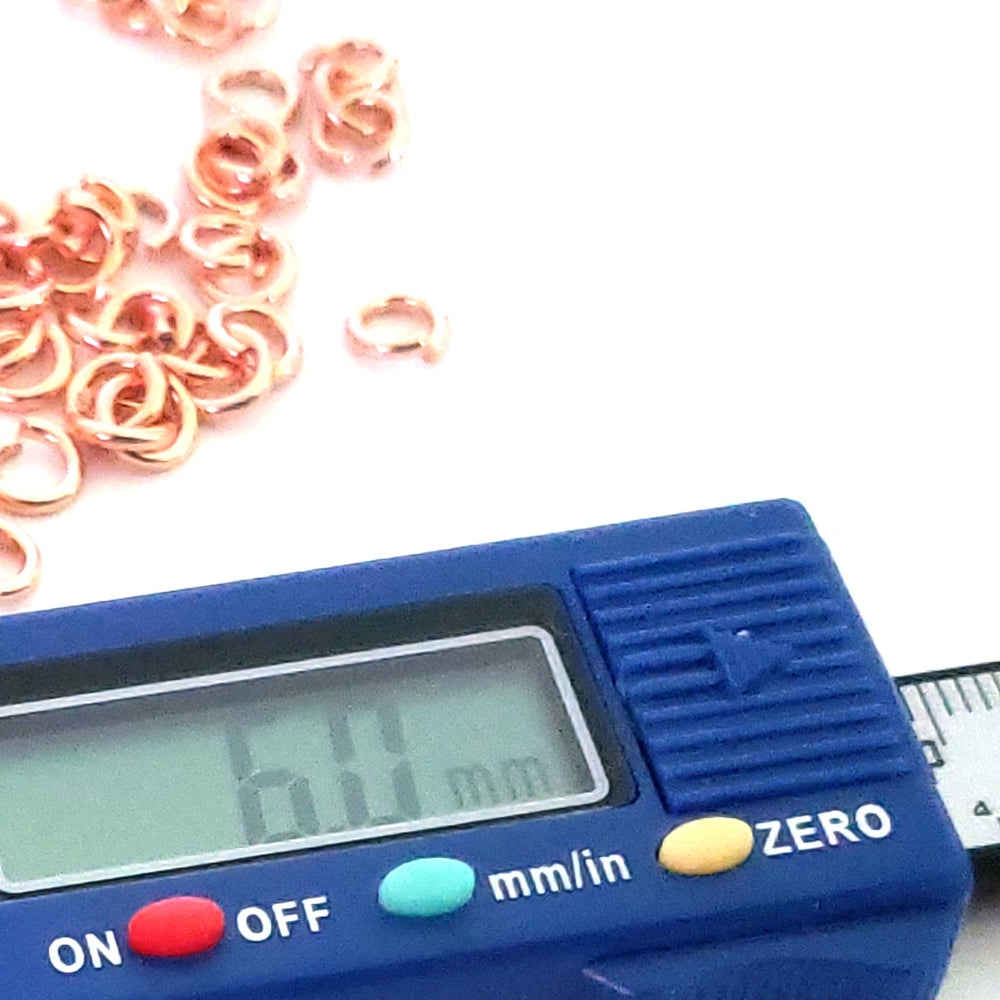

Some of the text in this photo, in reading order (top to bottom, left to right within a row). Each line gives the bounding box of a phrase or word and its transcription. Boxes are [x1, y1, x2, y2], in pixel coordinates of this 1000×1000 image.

[446, 756, 552, 808] mm
[756, 803, 892, 856] ZERO
[488, 849, 631, 900] mm/in
[48, 896, 329, 974] ON OFF
